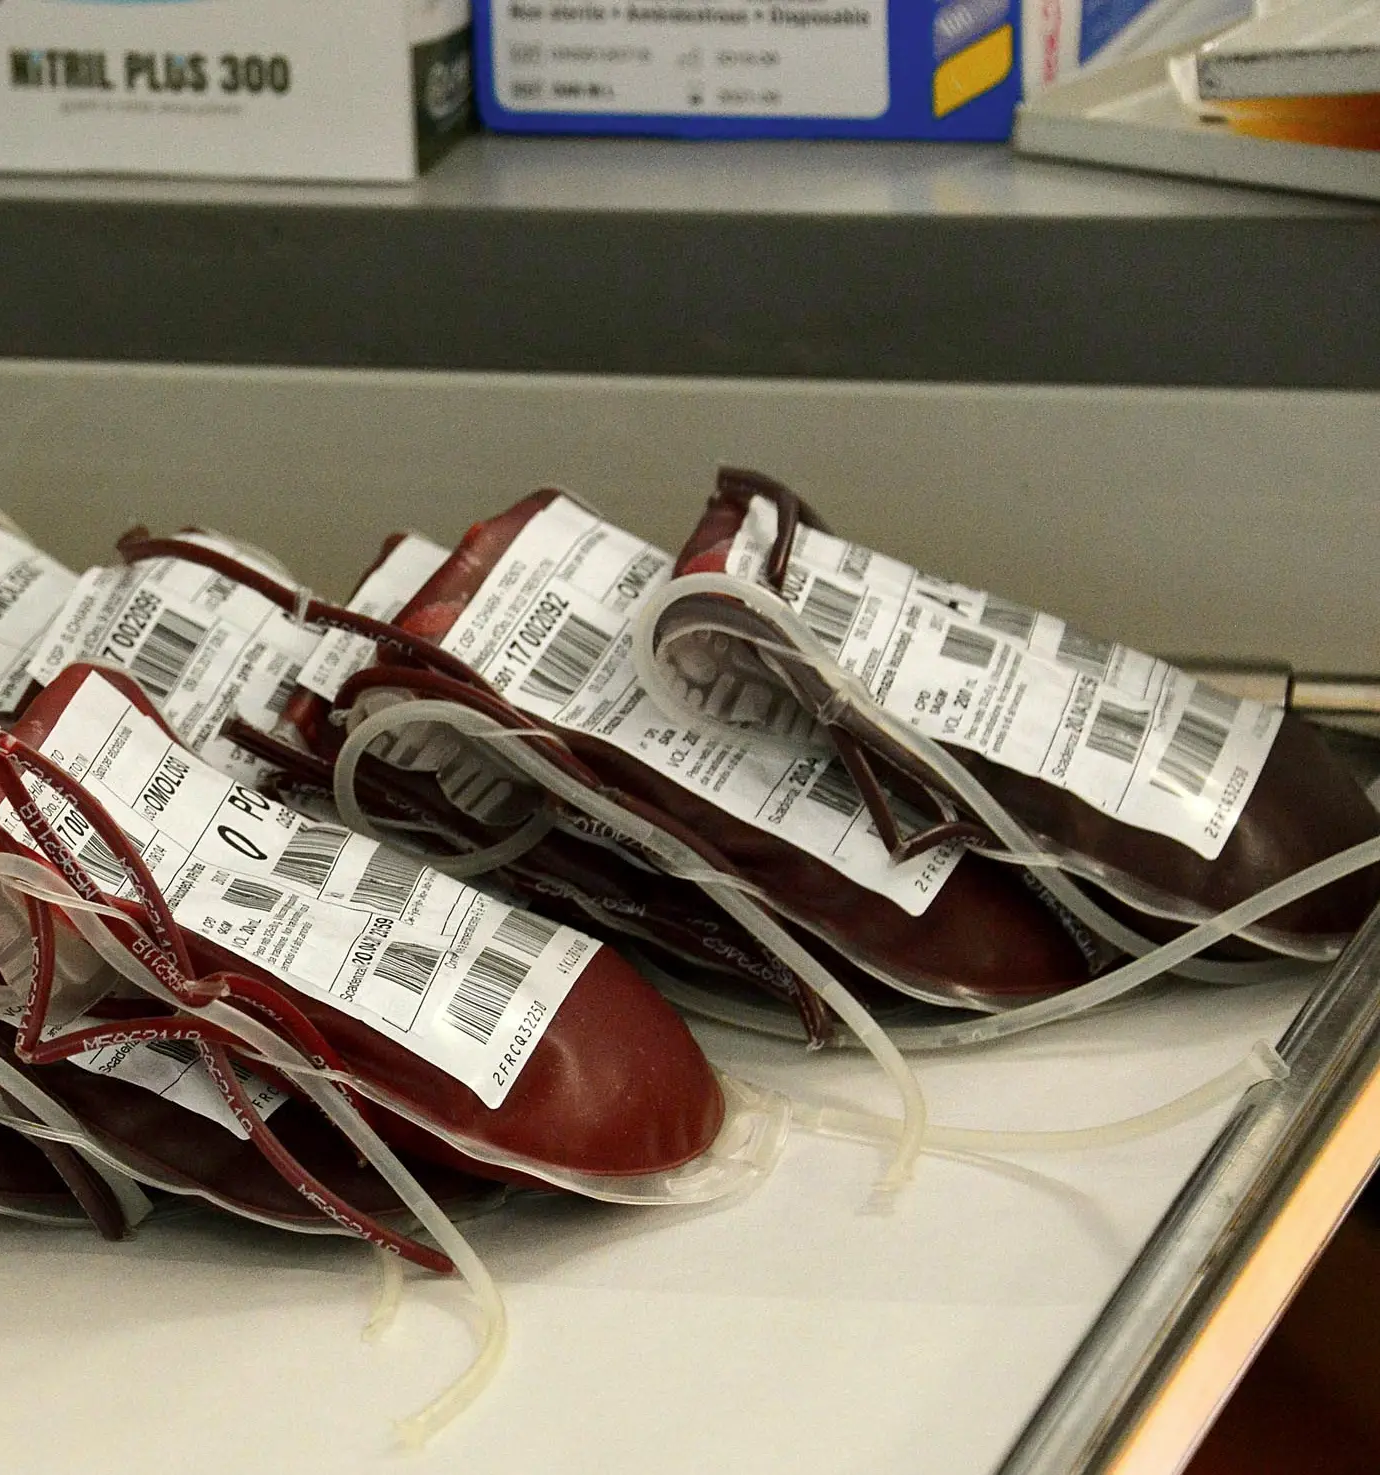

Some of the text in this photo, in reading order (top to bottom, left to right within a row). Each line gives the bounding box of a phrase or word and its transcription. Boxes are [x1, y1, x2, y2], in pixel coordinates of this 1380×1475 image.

[126, 51, 207, 93] PLUS
[221, 55, 291, 95] 300
[502, 639, 536, 669] 17
[138, 753, 193, 813] OMOLOGO
[225, 781, 275, 822] PO
[490, 998, 549, 1087] 2FRCQ32250
